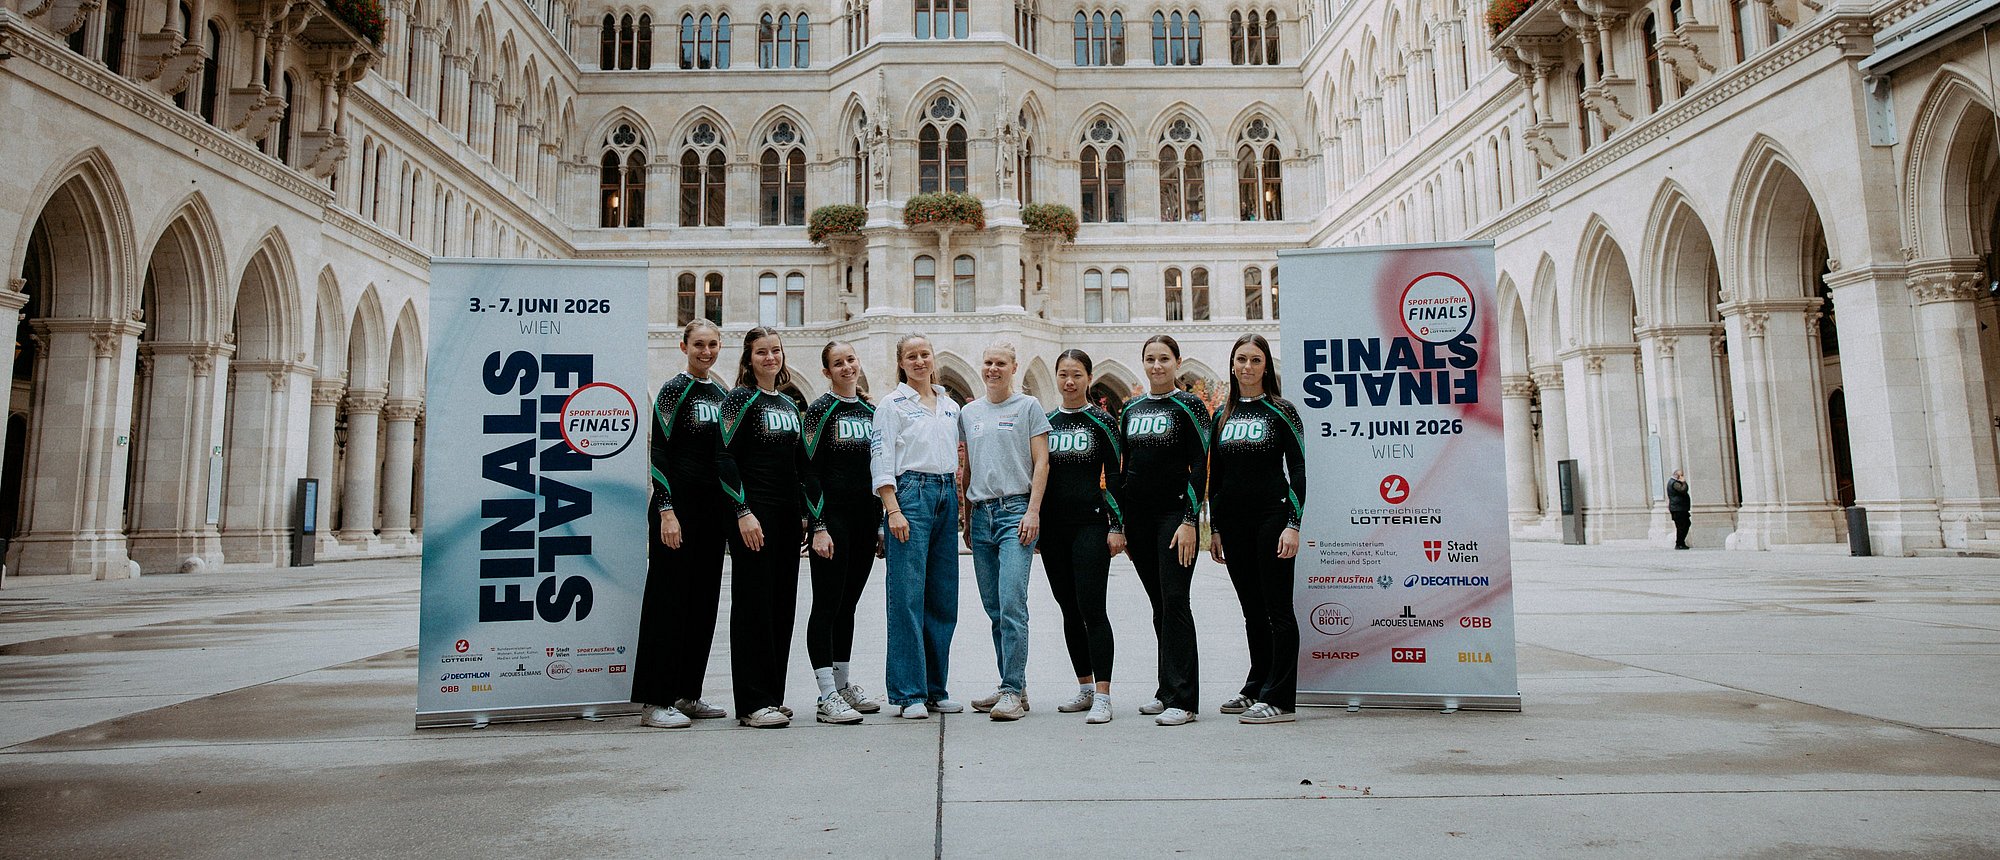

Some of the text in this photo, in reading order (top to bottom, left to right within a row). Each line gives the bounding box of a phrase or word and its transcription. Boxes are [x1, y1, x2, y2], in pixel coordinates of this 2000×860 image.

[1408, 296, 1467, 306] SPORT AUSTRIA
[517, 298, 558, 316] JUNI
[564, 299, 610, 314] 2026
[1409, 305, 1468, 321] FINALS
[519, 320, 561, 335] WIEN
[1303, 333, 1479, 373] FINALS
[1302, 370, 1479, 409] FINALS
[569, 408, 630, 417] SPORT AUSTRIA
[569, 418, 631, 432] FINALS
[1128, 415, 1169, 436] DDC
[1368, 420, 1410, 439] JUNI
[1416, 419, 1463, 435] 2026
[1221, 420, 1263, 442] DDC
[1048, 432, 1088, 453] DDC
[1371, 444, 1414, 459] WIEN
[478, 350, 540, 623] FINALS
[536, 353, 594, 624] FINALS
[1350, 507, 1442, 515] österreichische
[1350, 516, 1442, 525] LOTTERIEN
[1319, 540, 1384, 548] Bundesministerium
[1447, 540, 1478, 551] Stadt
[1351, 549, 1372, 557] Kunst,
[1375, 549, 1398, 557] Kultur,
[1447, 552, 1479, 563] Wien
[1362, 558, 1381, 566] Sport
[1308, 574, 1374, 584] SPORT AUSTRIA
[1421, 576, 1489, 586] DECATHLON
[1370, 619, 1444, 628] JACQUES LEMANS
[1459, 616, 1492, 629] ÖBB
[1312, 651, 1360, 660] SHARP
[1394, 650, 1423, 661] ORF
[1458, 652, 1492, 663] BILLA
[450, 672, 490, 680] DECATHLON
